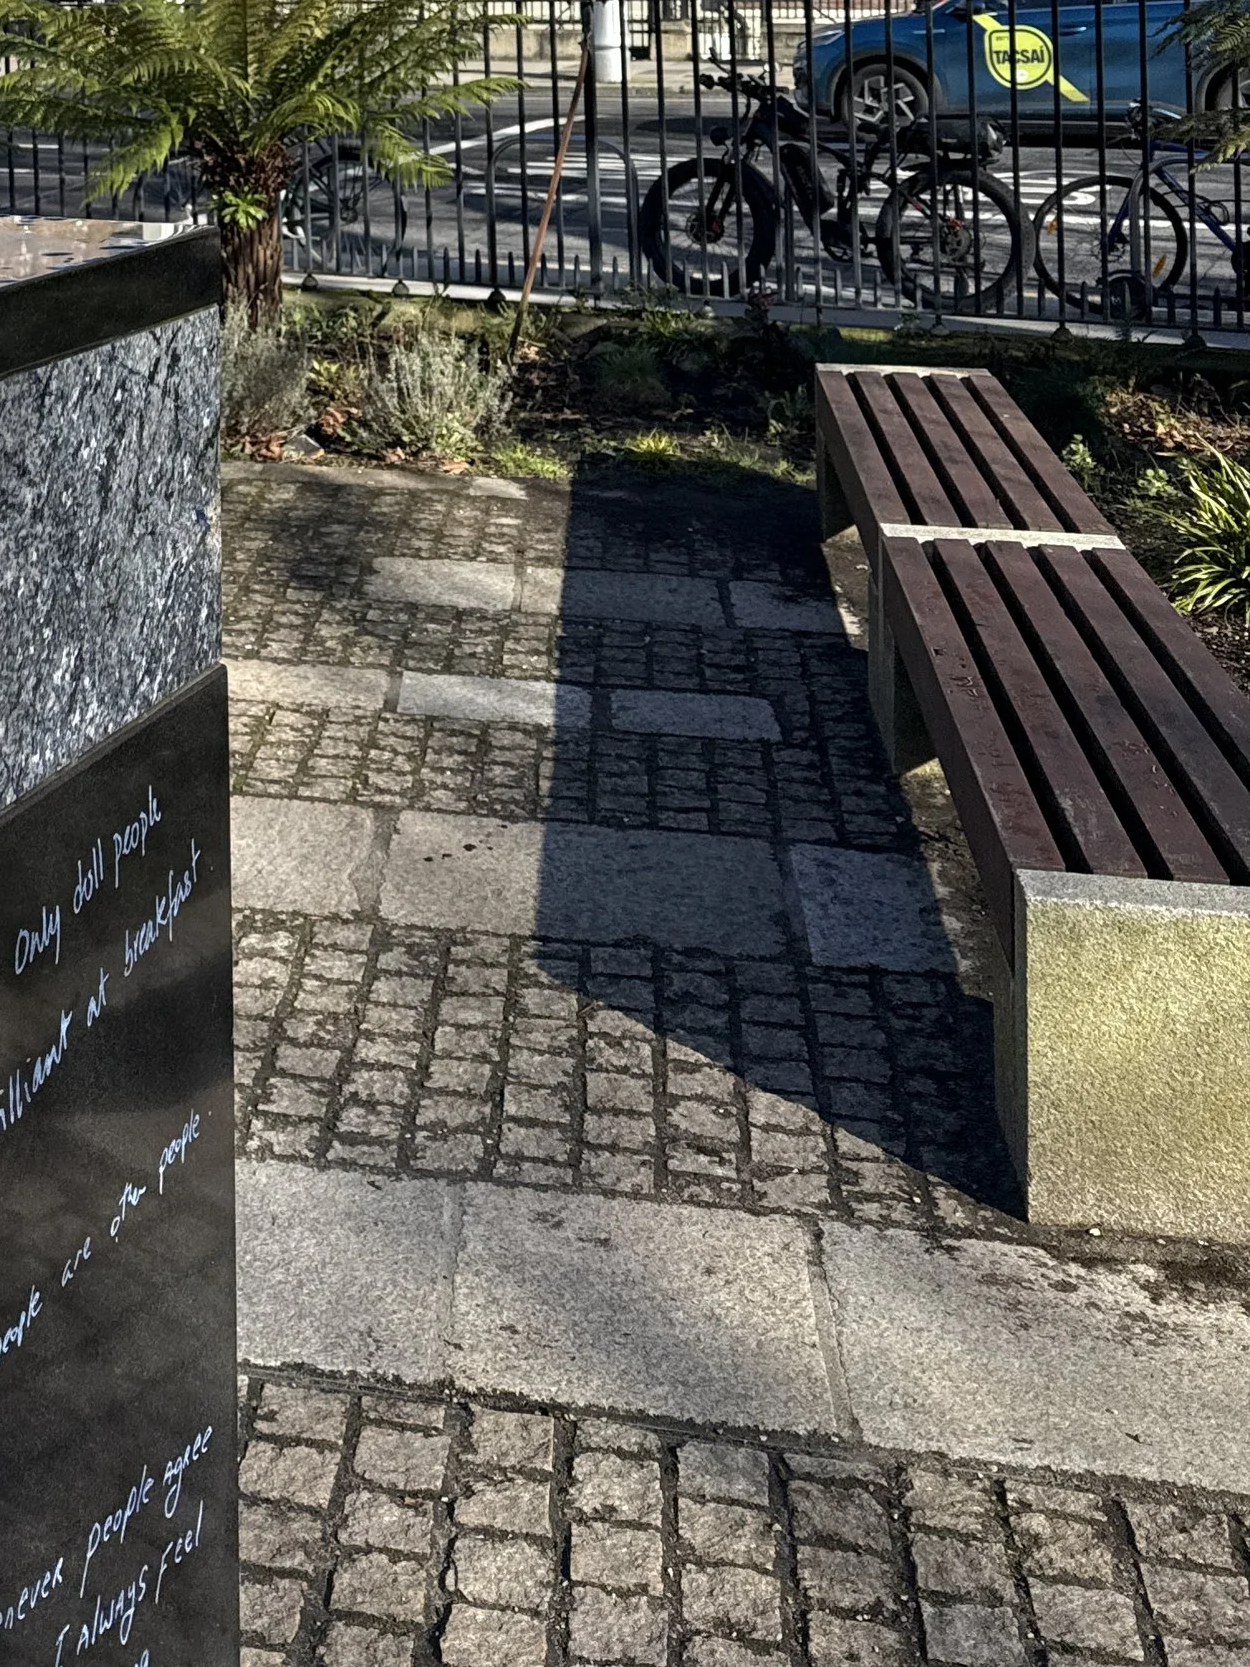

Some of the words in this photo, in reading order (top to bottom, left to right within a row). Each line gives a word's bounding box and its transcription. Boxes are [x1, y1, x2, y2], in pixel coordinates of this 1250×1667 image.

[15, 905, 61, 975] Only
[73, 837, 104, 914] dull
[114, 785, 161, 888] people
[87, 967, 109, 1027] at
[62, 1236, 91, 1287] are
